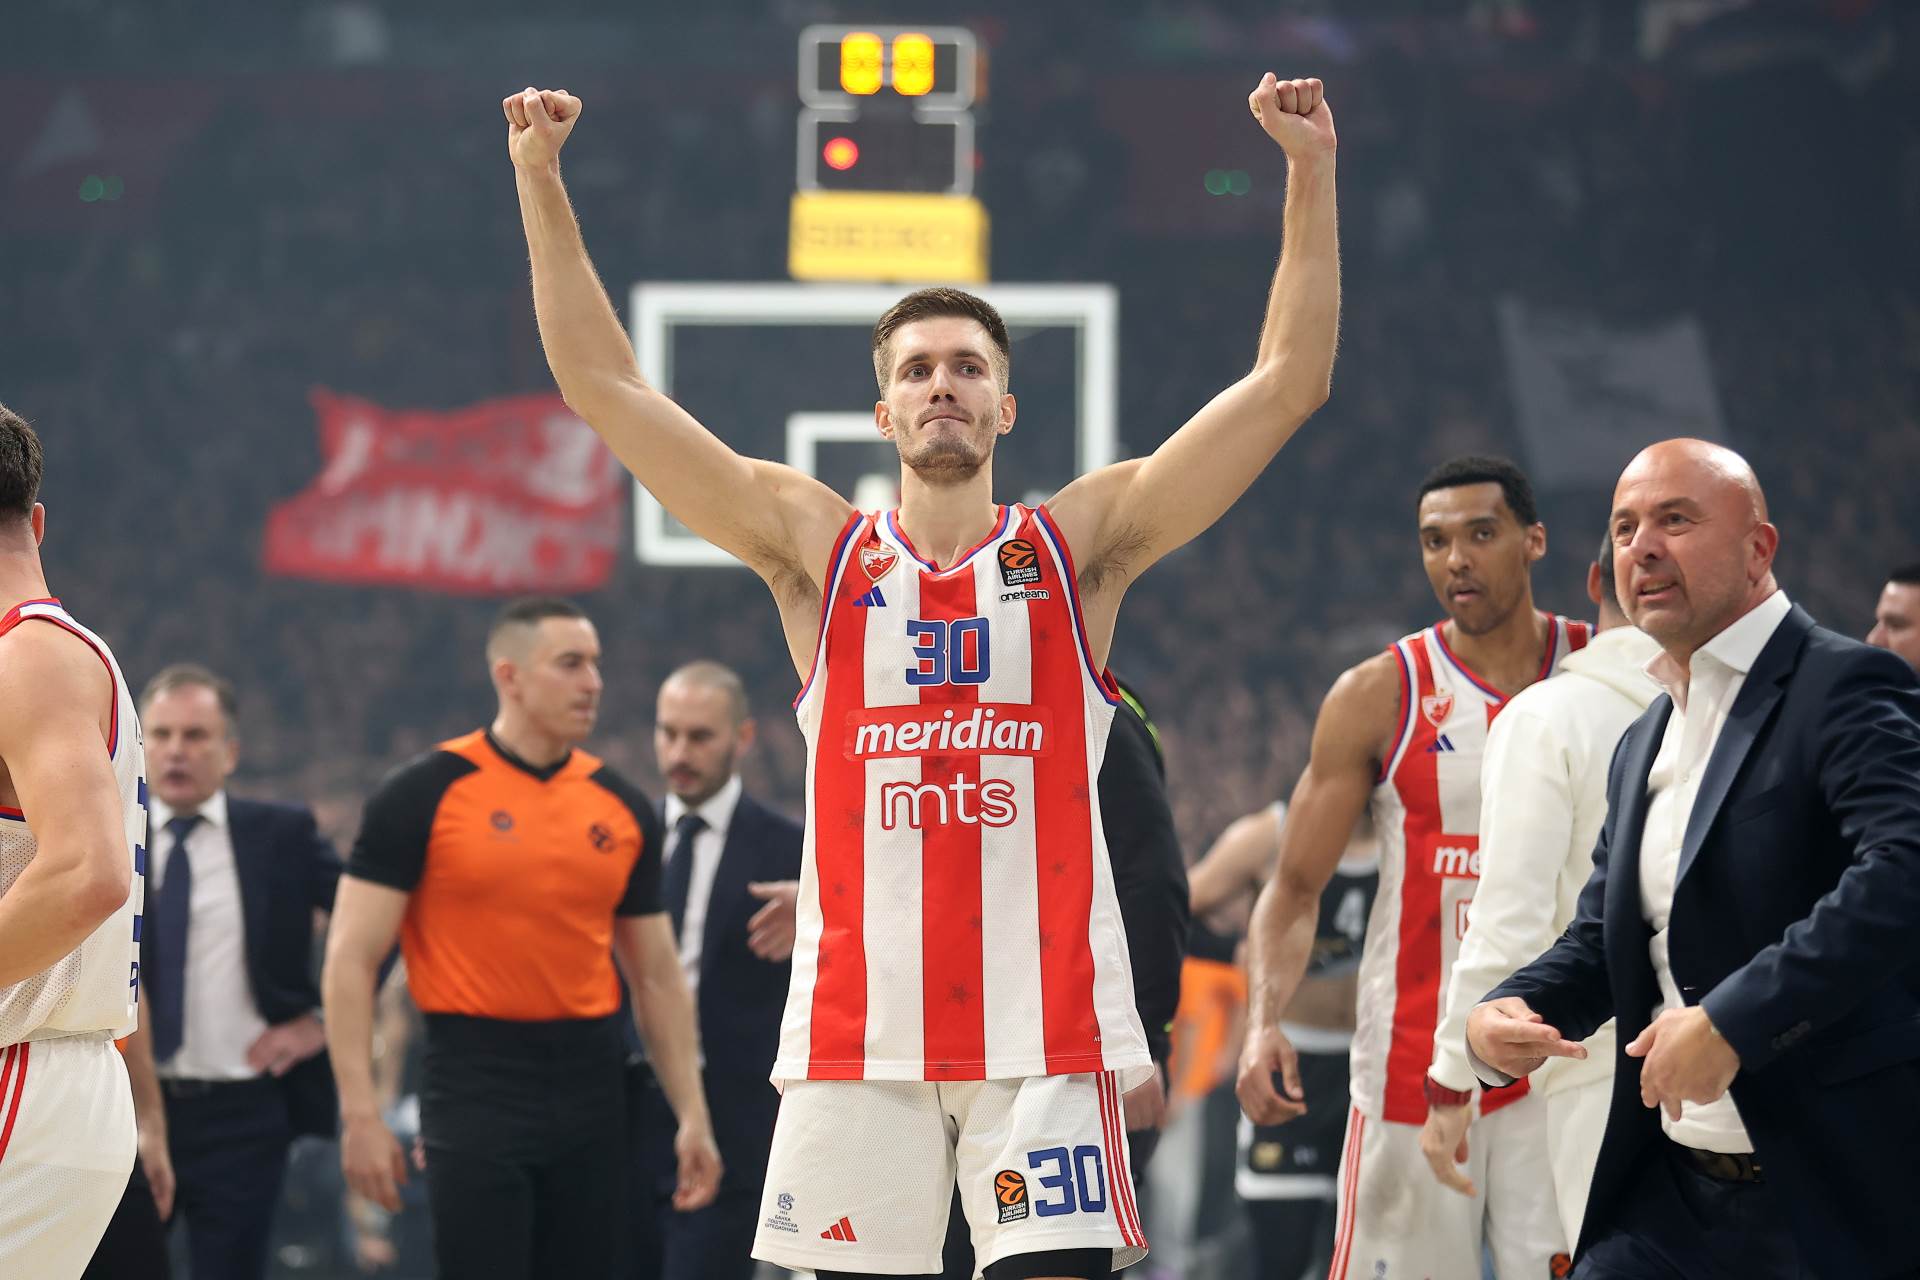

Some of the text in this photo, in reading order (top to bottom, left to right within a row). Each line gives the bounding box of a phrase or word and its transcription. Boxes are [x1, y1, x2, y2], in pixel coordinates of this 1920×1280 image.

[1006, 567, 1037, 575] TURKISH
[1007, 572, 1038, 580] AIRLINES
[1007, 577, 1039, 585] EuroLeague
[1000, 590, 1049, 601] oneteam
[905, 617, 990, 685] 30
[854, 707, 1043, 755] meridian
[882, 772, 1017, 829] mts
[1027, 1145, 1106, 1217] 30
[1001, 1202, 1026, 1213] TURKISH
[1002, 1207, 1026, 1218] AIRLINES
